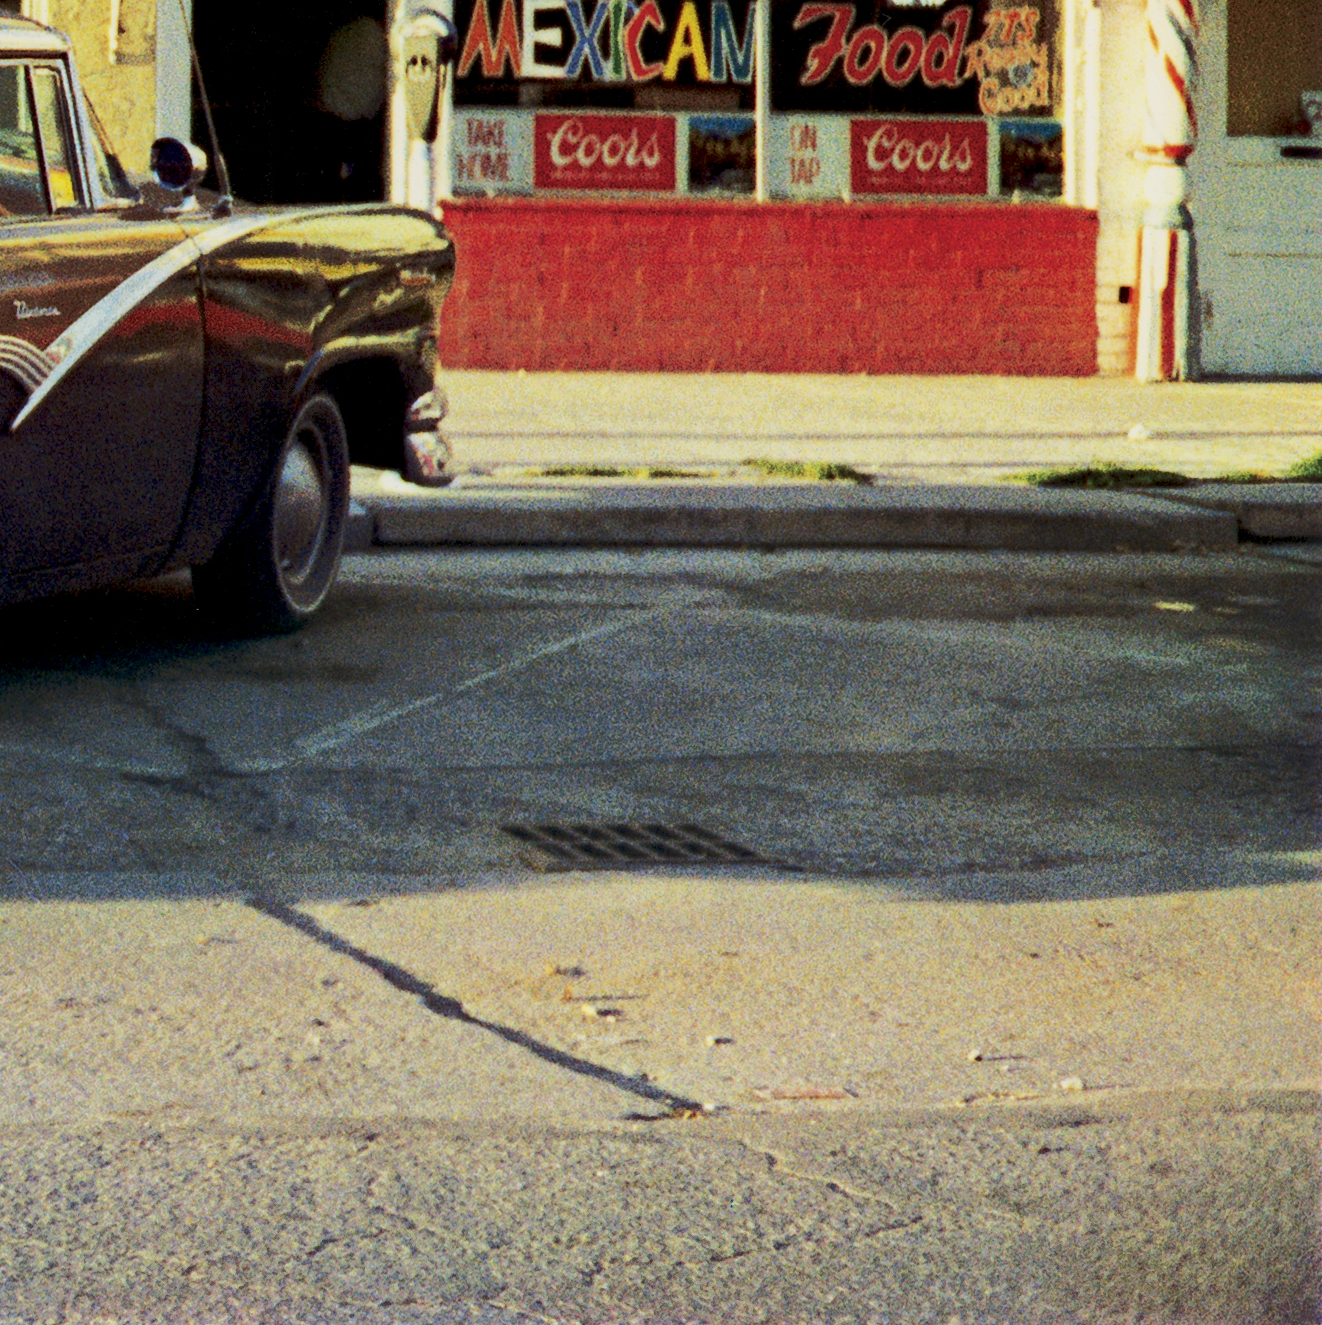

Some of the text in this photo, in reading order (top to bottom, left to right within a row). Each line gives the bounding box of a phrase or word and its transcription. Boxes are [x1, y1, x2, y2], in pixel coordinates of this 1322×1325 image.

[793, 2, 973, 88] Food
[547, 119, 660, 168] Coors
[863, 124, 973, 173] Coors
